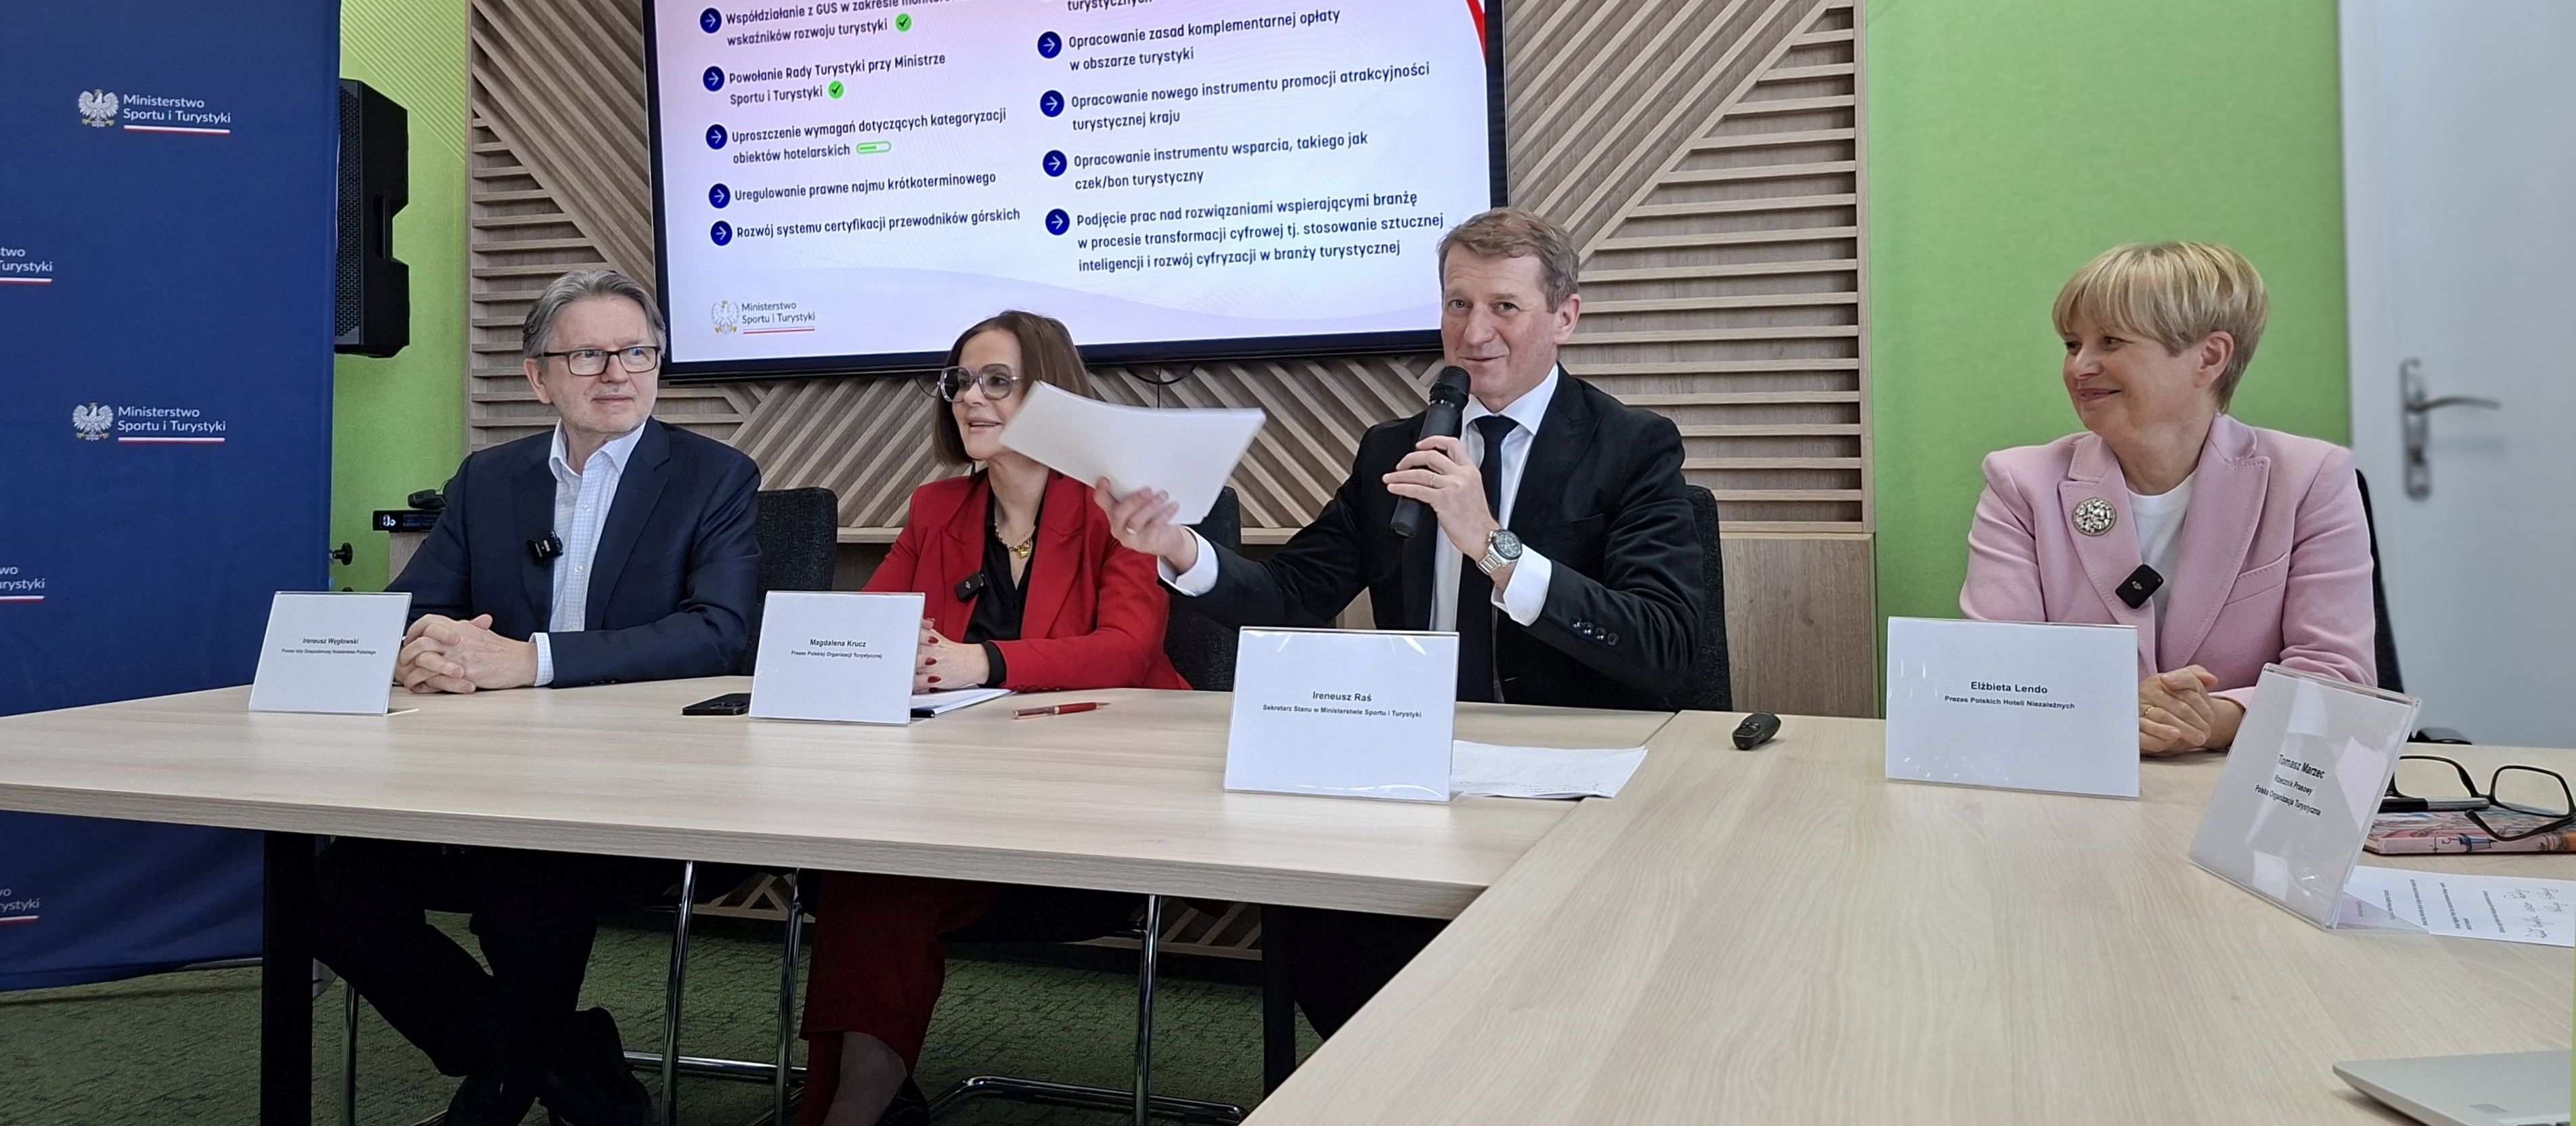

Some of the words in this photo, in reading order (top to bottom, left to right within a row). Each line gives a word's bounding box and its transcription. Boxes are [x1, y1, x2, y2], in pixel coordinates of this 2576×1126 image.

[725, 5, 805, 26] Współdziałanie
[808, 6, 813, 16] z
[816, 2, 837, 15] GUS
[840, 3, 850, 13] w
[852, 0, 899, 12] zakresie
[1067, 0, 1152, 13] turystyczny
[726, 28, 791, 46] wskaźników
[793, 24, 835, 40] rozwoju
[838, 18, 888, 37] turystyki
[1068, 28, 1145, 50] Opracowanie
[1149, 24, 1185, 40] zasad
[1187, 12, 1296, 37] komplementarnej
[1300, 9, 1340, 26] opłaty
[729, 67, 783, 84] Powołanie
[785, 65, 812, 80] Rady
[814, 59, 865, 77] Turystyki
[868, 60, 892, 74] przy
[894, 53, 946, 68] Ministrze
[1069, 61, 1080, 71] w
[1083, 56, 1136, 70] obszarze
[1139, 46, 1194, 66] turystyki
[1071, 89, 1148, 110] Opracowanie
[1152, 87, 1198, 101] nowego
[1202, 79, 1278, 96] instrumentu
[1282, 70, 1336, 92] promocji
[1340, 61, 1430, 83] atrakcyjności
[123, 93, 205, 108] Ministerstwo
[730, 92, 765, 108] Sportu
[767, 89, 770, 102] i
[772, 85, 823, 103] Turystyki
[123, 108, 165, 121] Sportu
[168, 110, 172, 121] i
[175, 110, 231, 125] Turystyki
[732, 125, 802, 145] Uproszczenie
[804, 120, 856, 139] wymagań
[858, 114, 928, 133] dotyczących
[930, 107, 1006, 127] kategoryzacji
[1072, 112, 1146, 132] turystycznej
[1150, 109, 1180, 126] kraju
[733, 149, 781, 164] obiektów
[783, 144, 850, 160] hotelarskich
[1074, 149, 1151, 170] Opracowanie
[1154, 145, 1228, 161] instrumentu
[1231, 137, 1293, 156] wsparcia,
[1296, 134, 1345, 150] takiego
[1348, 131, 1368, 149] jak
[735, 184, 806, 203] Uregulowanie
[809, 184, 849, 198] prawne
[852, 179, 885, 195] najmu
[888, 173, 996, 190] krótkoterminowego
[1075, 175, 1129, 190] czek/bon
[1132, 171, 1204, 188] turystyczny
[1076, 211, 1127, 228] Podjęcie
[1130, 212, 1156, 226] prac
[1160, 207, 1182, 221] nad
[1185, 200, 1273, 220] rozwiązaniami
[1276, 193, 1370, 215] wspierającymi
[1373, 191, 1418, 207] branżę
[737, 223, 774, 239] Rozwój
[777, 223, 822, 238] systemu
[824, 216, 886, 234] certyfikacji
[888, 211, 968, 231] przewodników
[971, 208, 1020, 226] górskich
[1077, 239, 1088, 249] w
[1091, 233, 1141, 251] procesie
[1144, 227, 1226, 245] transformacji
[1229, 223, 1284, 242] cyfrowej
[1287, 222, 1300, 239] tj.
[1303, 217, 1377, 235] stosowanie
[1381, 213, 1443, 230] sztucznej
[1078, 255, 1143, 274] inteligencji
[1147, 255, 1151, 268] i
[1154, 252, 1193, 269] rozwój
[1196, 248, 1257, 267] cyfryzacji
[1259, 251, 1271, 261] w
[1274, 245, 1316, 261] branży
[1319, 239, 1400, 259] turystycznej
[741, 302, 797, 312] Ministerstwo
[742, 314, 770, 326] Sportu
[772, 313, 774, 323] i
[777, 311, 816, 324] Turystyki
[118, 406, 200, 418] Ministerstwo
[117, 420, 160, 433] Sportu
[162, 420, 167, 431] i
[169, 420, 226, 433] Turystyki
[0, 578, 45, 592] rystyki
[810, 638, 846, 647] Magdalena
[1313, 691, 1352, 701] Ireneusz
[1354, 693, 1372, 702] Raś
[1971, 681, 2011, 692] Elżbieta
[2015, 684, 2048, 694] Lendo
[1320, 706, 1363, 715] Ministerstwie
[1364, 709, 1387, 717] Sportu
[1391, 710, 1422, 719] Turystyki
[1944, 695, 1969, 703] Prezes
[1970, 697, 2001, 705] Polskich
[2026, 700, 2075, 710] Niezależnych
[2277, 754, 2302, 771] Tomasz
[2301, 762, 2326, 779] Marzec
[0, 898, 40, 913] ystyki
